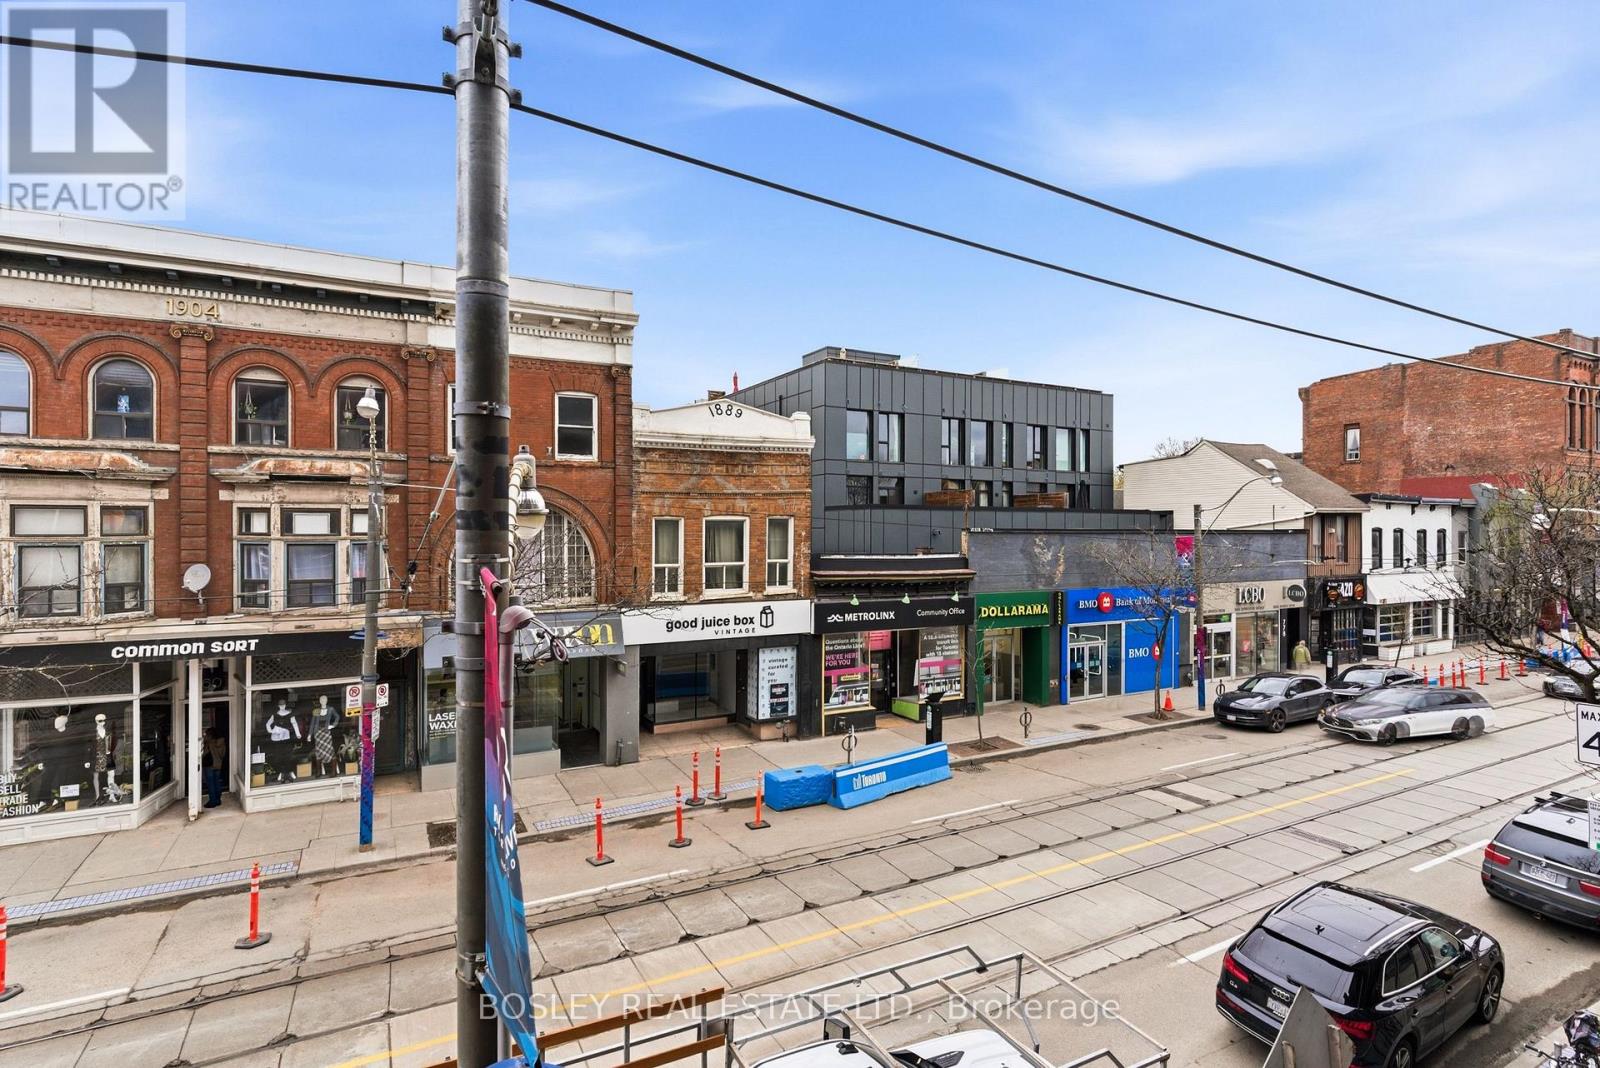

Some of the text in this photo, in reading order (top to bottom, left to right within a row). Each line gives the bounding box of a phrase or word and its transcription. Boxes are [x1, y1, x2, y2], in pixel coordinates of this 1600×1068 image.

[166, 298, 220, 319] 1904
[708, 403, 743, 418] 1889
[1238, 586, 1266, 604] LCBO
[1289, 589, 1304, 597] LCBO
[1079, 599, 1098, 609] BMO
[1115, 597, 1134, 606] Bank
[845, 610, 896, 622] METROLINX
[916, 607, 965, 617] Community Office
[981, 604, 1049, 617] DOLLARAMA
[666, 615, 755, 633] good juice box
[714, 628, 756, 636] VINTAGE
[1128, 647, 1149, 658] BMO
[428, 711, 457, 721] LASE
